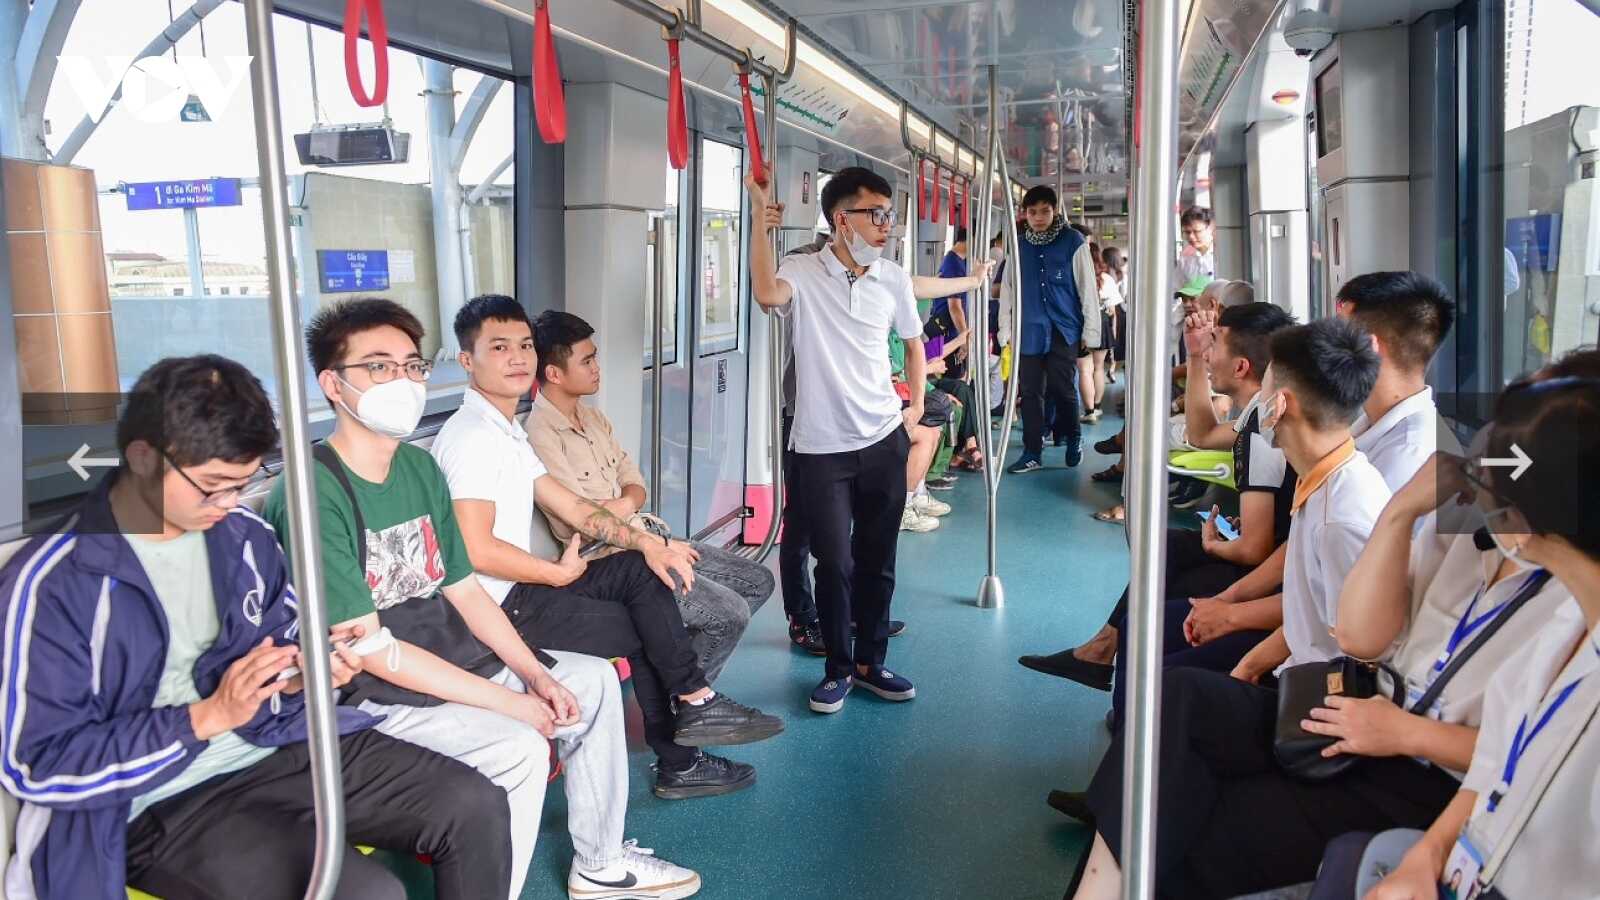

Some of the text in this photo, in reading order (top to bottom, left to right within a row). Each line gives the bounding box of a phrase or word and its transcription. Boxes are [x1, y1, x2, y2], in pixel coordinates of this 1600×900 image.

[155, 185, 161, 205] 1
[174, 184, 184, 194] Ga
[185, 183, 201, 194] Kim
